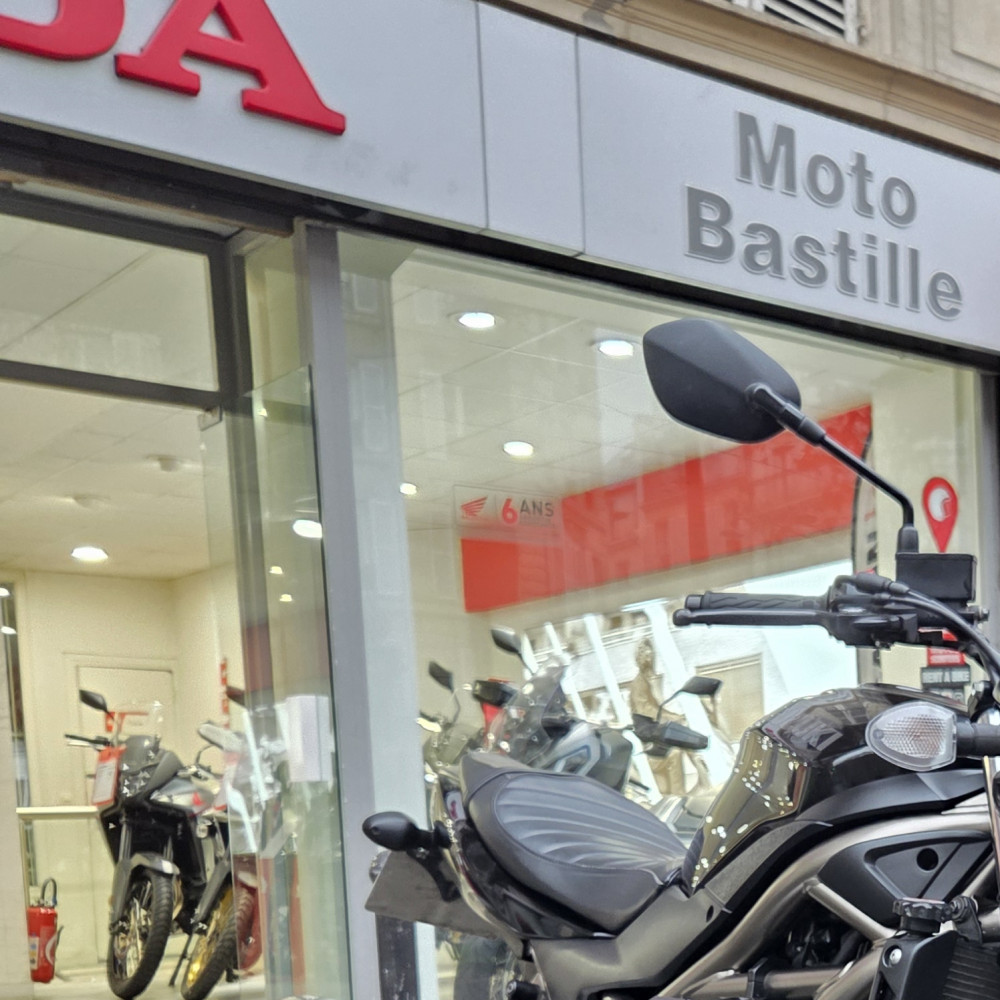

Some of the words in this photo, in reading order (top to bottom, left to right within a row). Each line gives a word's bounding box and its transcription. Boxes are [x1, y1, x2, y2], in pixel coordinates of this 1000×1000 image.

[0, 0, 346, 136] A
[735, 109, 918, 229] Moto
[684, 183, 963, 321] Bastille
[502, 497, 518, 525] 6
[520, 499, 555, 518] ANS
